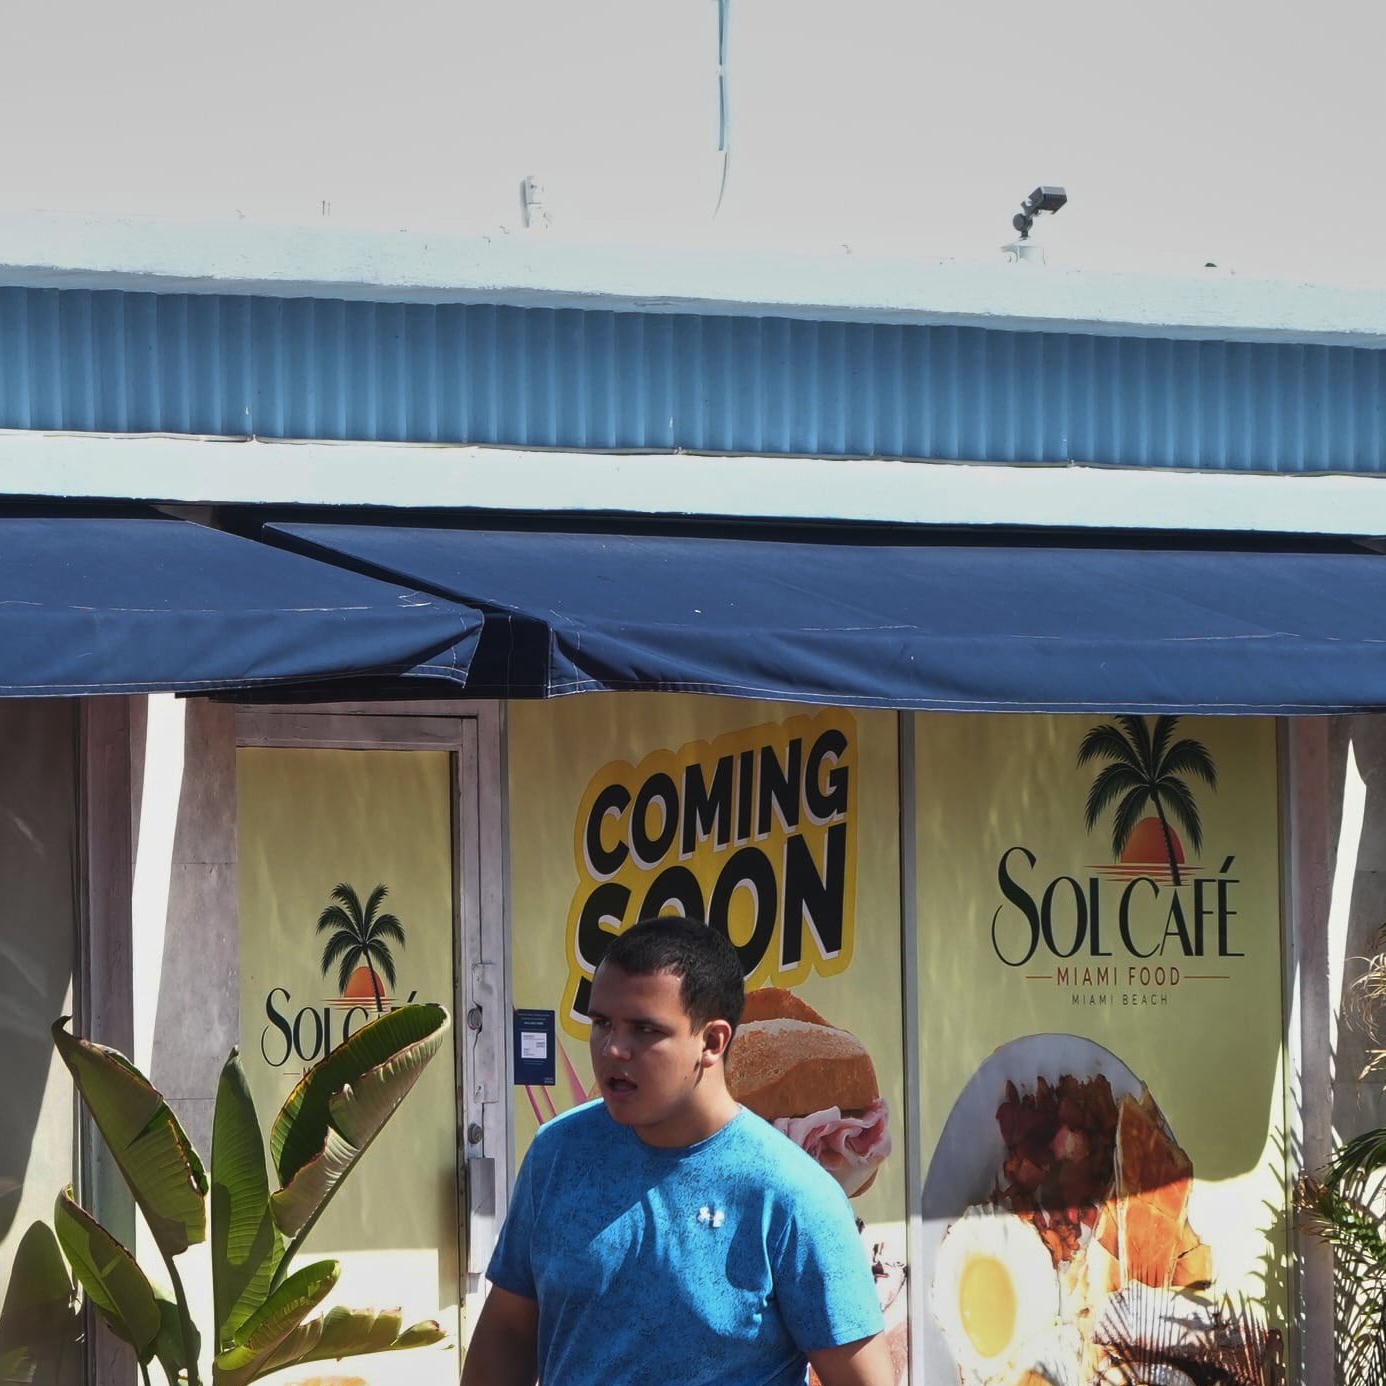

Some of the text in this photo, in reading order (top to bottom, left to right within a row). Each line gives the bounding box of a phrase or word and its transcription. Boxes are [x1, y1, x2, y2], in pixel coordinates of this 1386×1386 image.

[583, 729, 849, 882] COMING
[1057, 967, 1180, 986] MIAMI FOOD
[1071, 994, 1168, 1006] MIAMI BEACH
